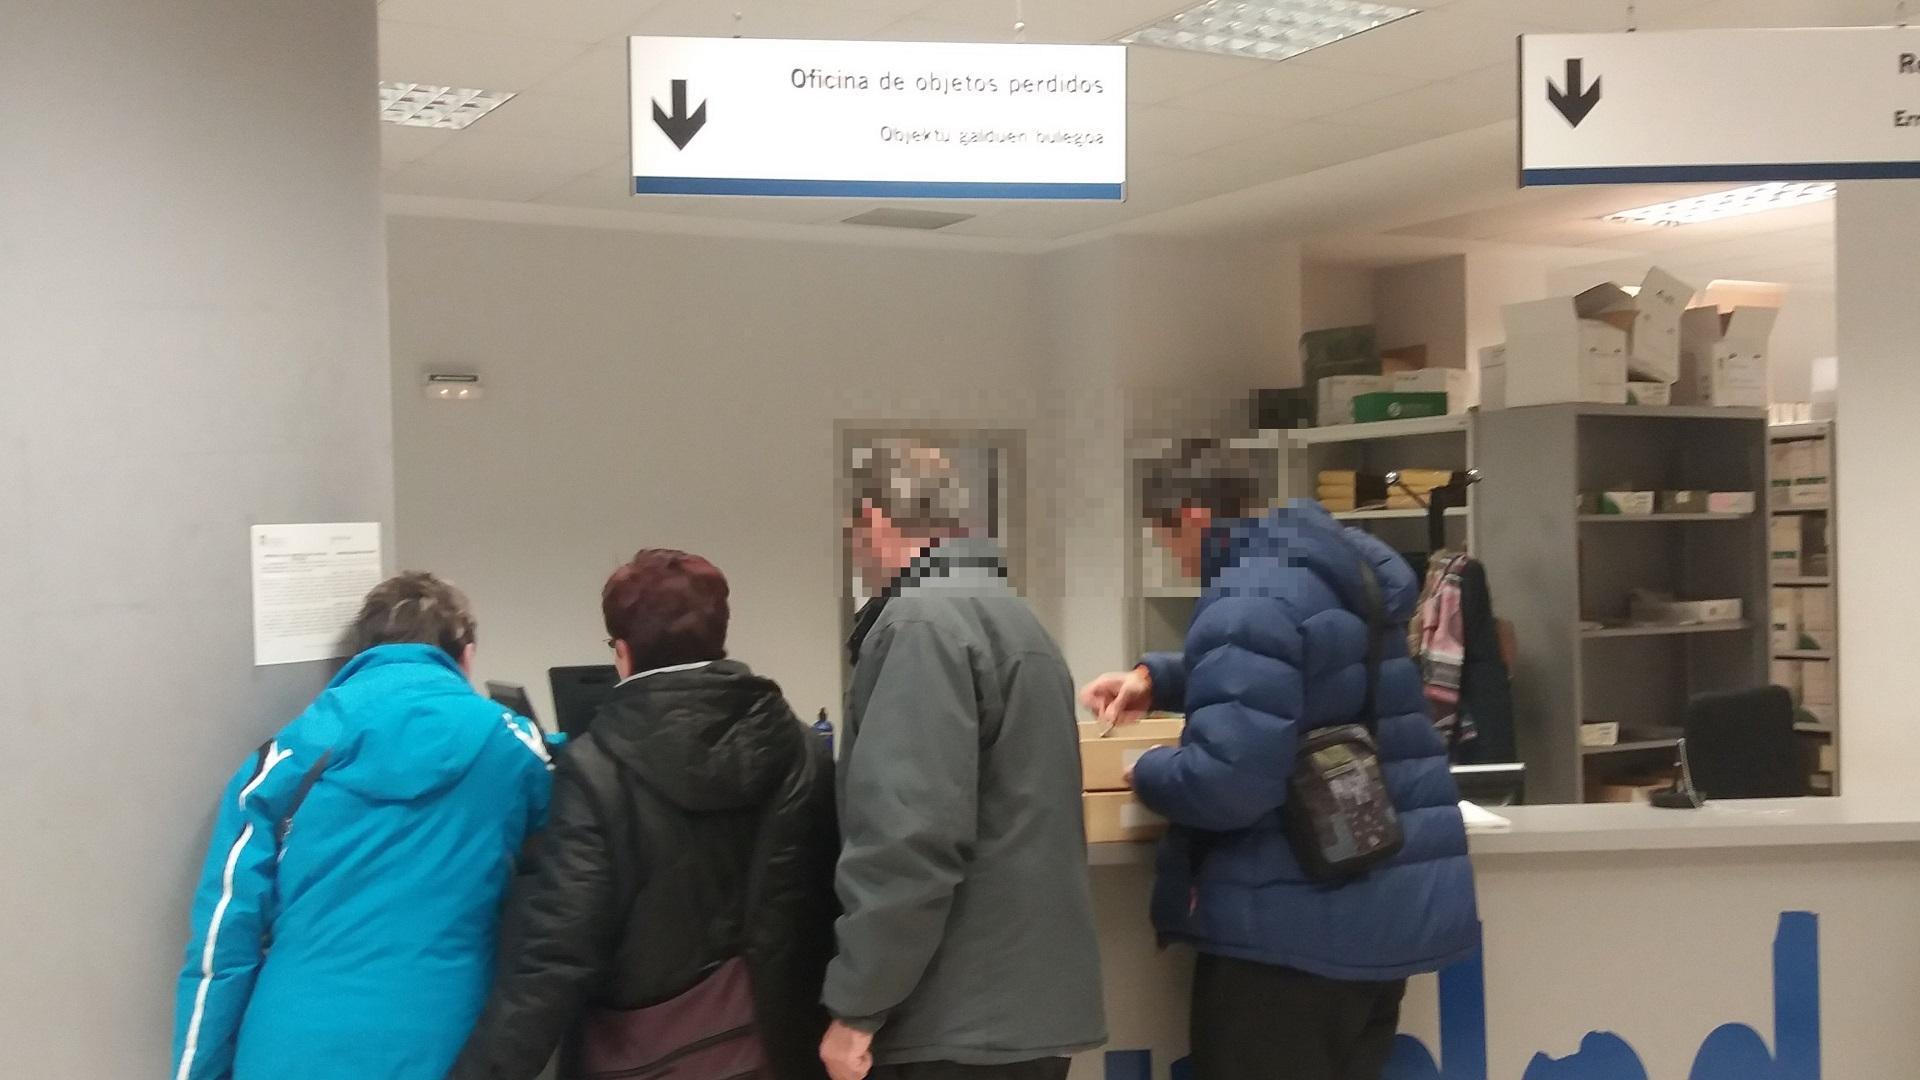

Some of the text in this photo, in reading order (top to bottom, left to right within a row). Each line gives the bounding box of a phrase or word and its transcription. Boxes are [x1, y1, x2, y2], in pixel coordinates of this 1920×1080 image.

[790, 68, 1104, 96] Oficina de objetos perdidos
[880, 125, 1104, 147] Objektu galduen bulegoa
